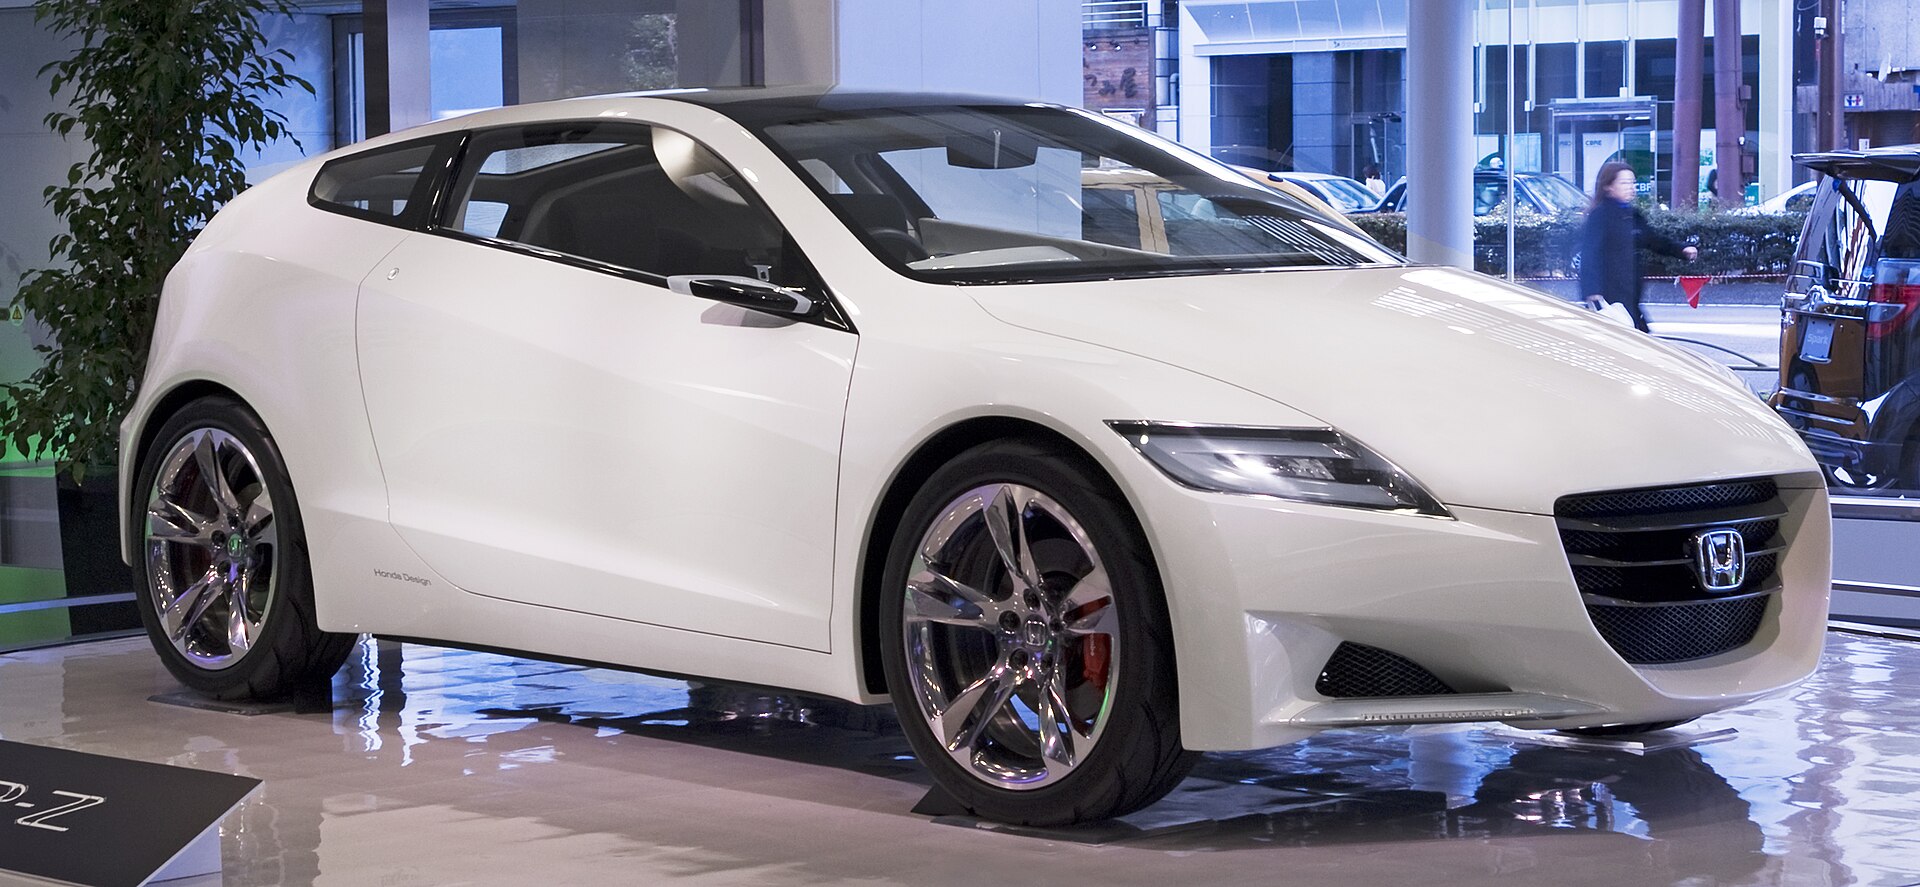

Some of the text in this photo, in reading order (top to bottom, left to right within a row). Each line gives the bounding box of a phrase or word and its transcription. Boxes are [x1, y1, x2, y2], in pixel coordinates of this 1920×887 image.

[1807, 333, 1829, 345] Spark
[373, 568, 432, 586] Honda Design
